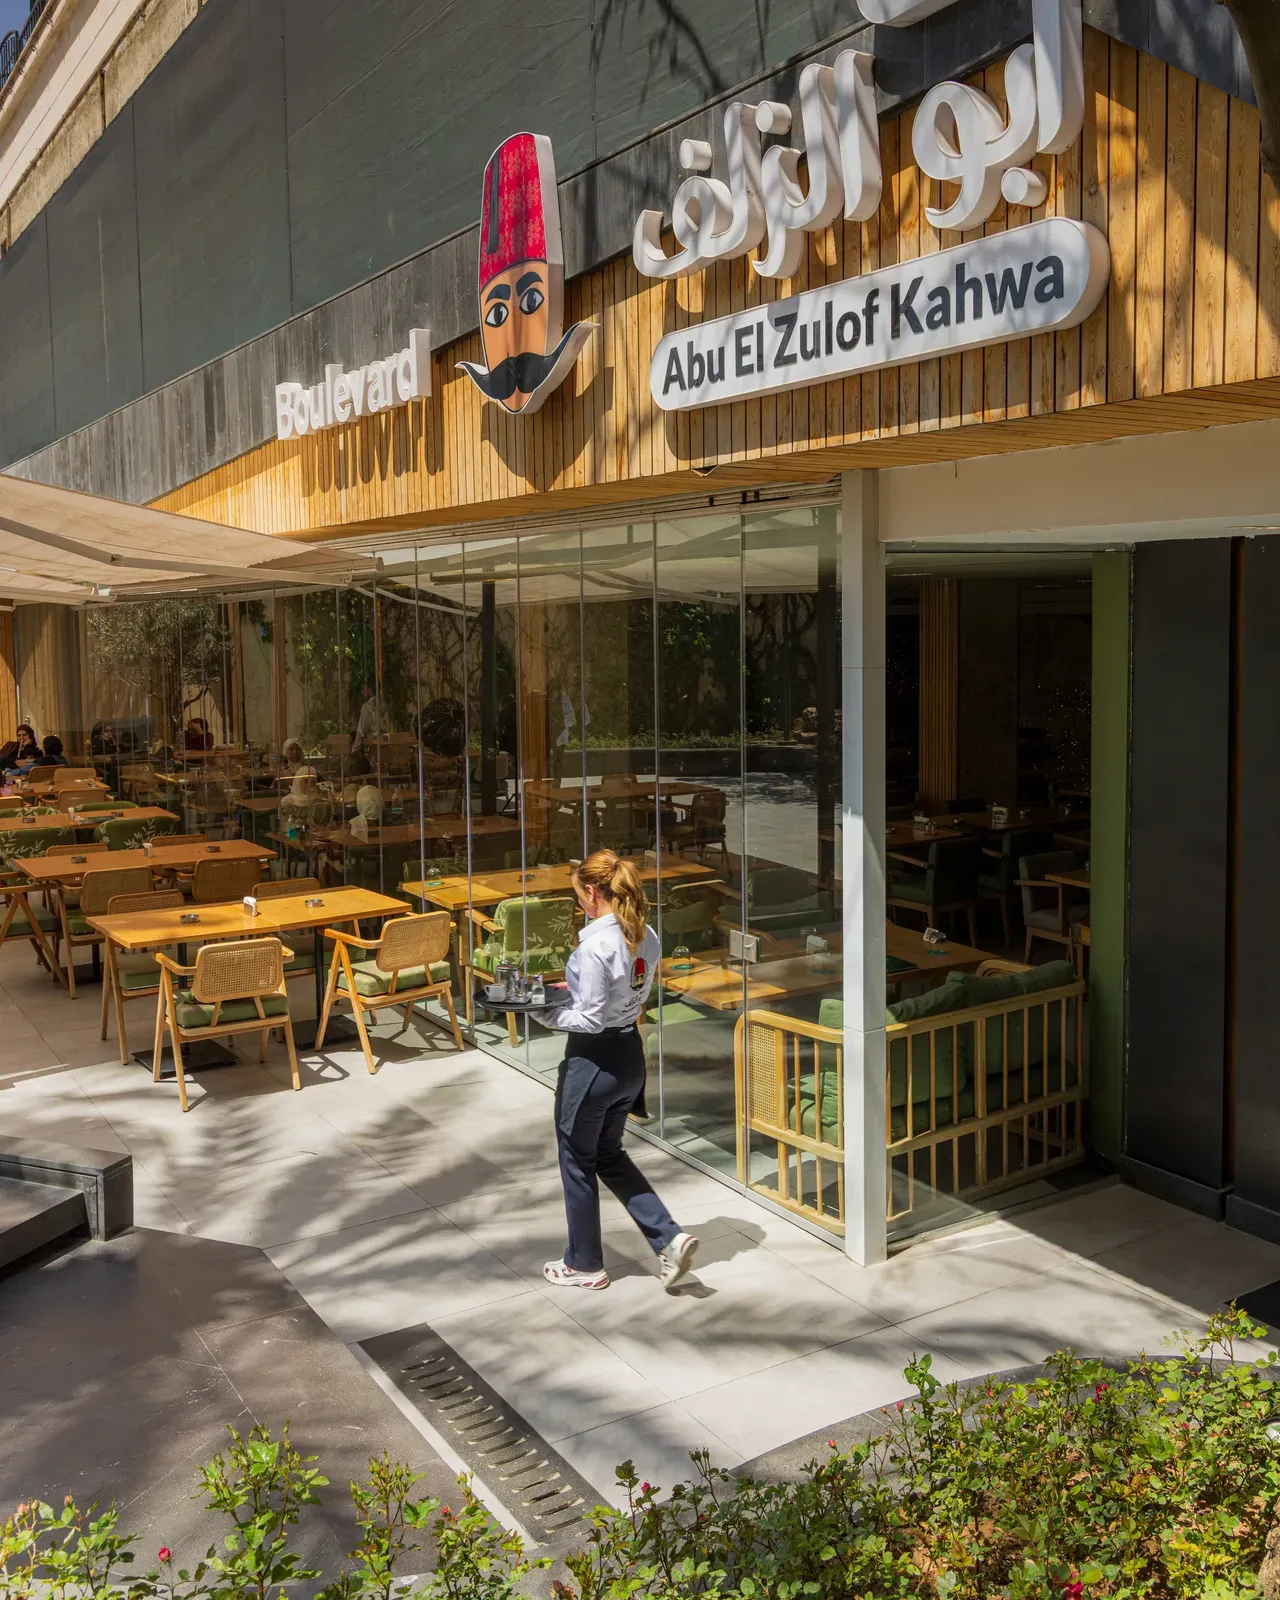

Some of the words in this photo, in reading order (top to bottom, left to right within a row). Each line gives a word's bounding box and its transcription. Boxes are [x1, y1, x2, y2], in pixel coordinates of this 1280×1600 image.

[633, 49, 882, 279] الزلف
[275, 328, 432, 440] Boulevard
[662, 340, 726, 396] Abu
[734, 320, 765, 378] El
[773, 287, 880, 369] Zulof
[890, 255, 1065, 341] Kahwa
